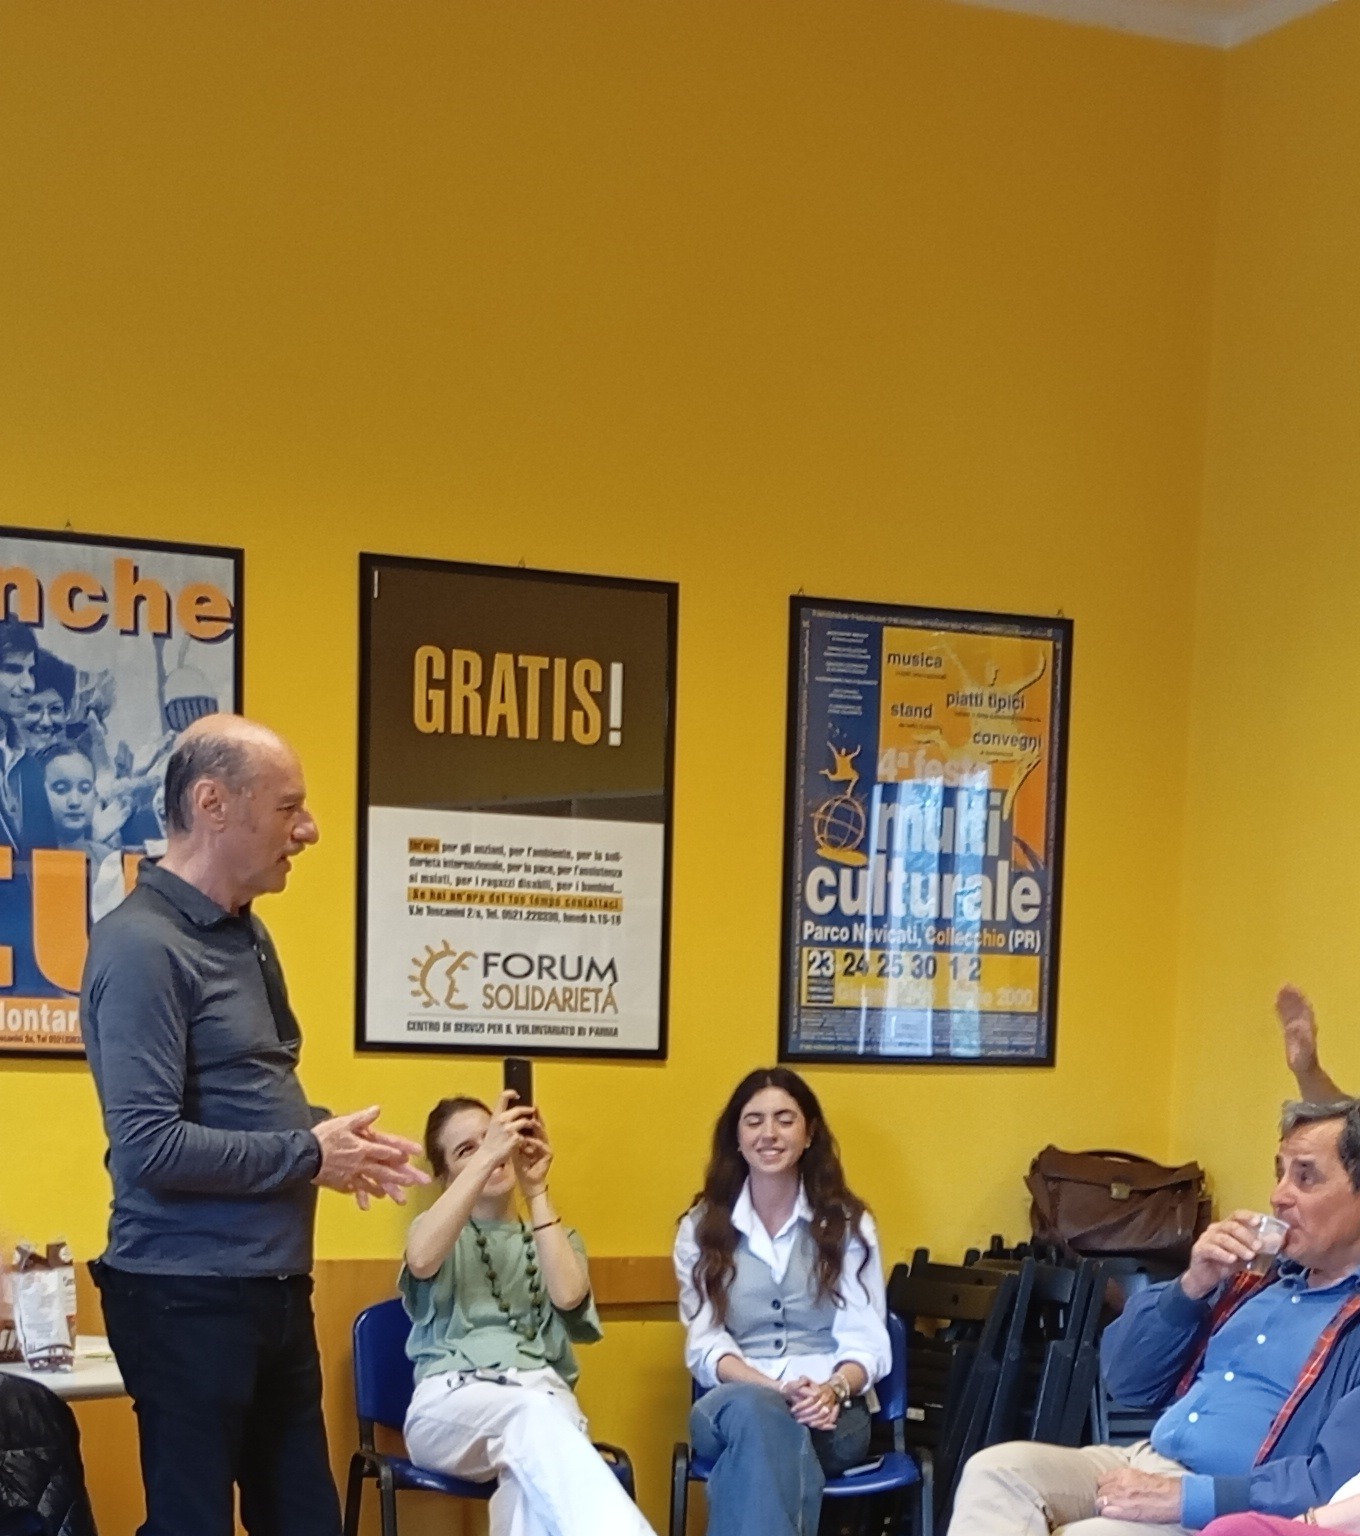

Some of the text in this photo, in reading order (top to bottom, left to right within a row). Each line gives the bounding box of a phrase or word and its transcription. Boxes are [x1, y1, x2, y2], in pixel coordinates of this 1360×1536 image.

[887, 651, 943, 668] musica
[413, 644, 624, 747] GRATIS!
[946, 691, 1024, 713] piatti tipici
[891, 702, 934, 719] stand
[973, 730, 1041, 754] convegni
[455, 876, 472, 887] per
[481, 877, 515, 889] ragazzi
[557, 882, 572, 892] per
[805, 854, 1041, 923] culturale
[803, 921, 1041, 952] Parco Nevicati, Collecchio (PR)
[483, 952, 619, 983] FORUM
[808, 950, 835, 977] 23
[843, 952, 869, 977] 24
[876, 954, 903, 978] 25
[911, 955, 937, 980] 30
[968, 957, 981, 981] 2
[407, 1020, 439, 1032] CENTRO
[443, 1021, 452, 1033] DI
[487, 1023, 503, 1034] PER
[515, 1024, 575, 1036] VOLONTARIATO
